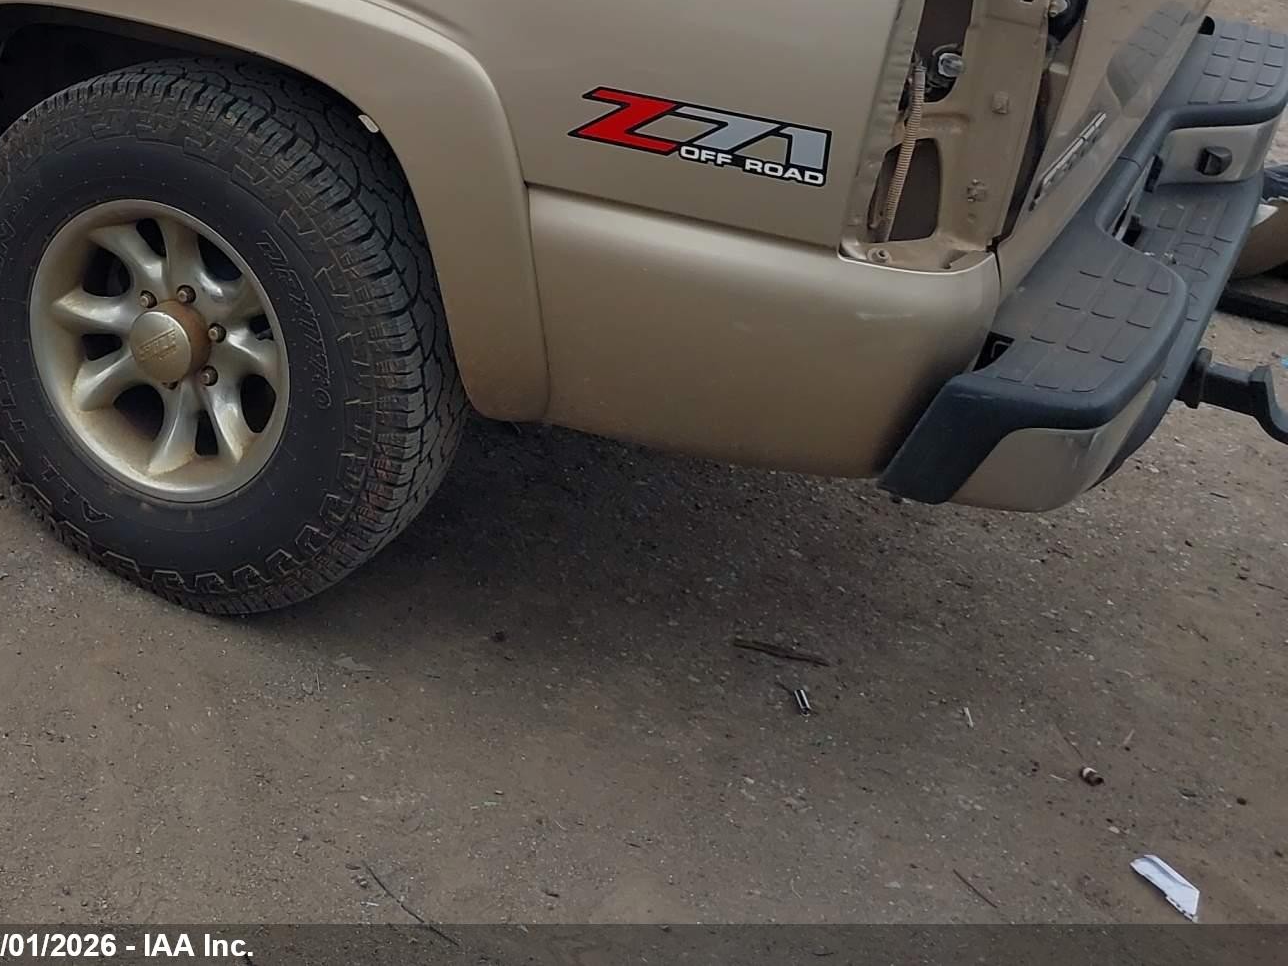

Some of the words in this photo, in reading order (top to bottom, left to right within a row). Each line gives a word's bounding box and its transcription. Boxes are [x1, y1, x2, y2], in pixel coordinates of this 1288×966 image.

[568, 86, 832, 172] Z71
[679, 145, 733, 166] OFF
[744, 158, 824, 185] ROAD
[40, 455, 115, 523] ALL
